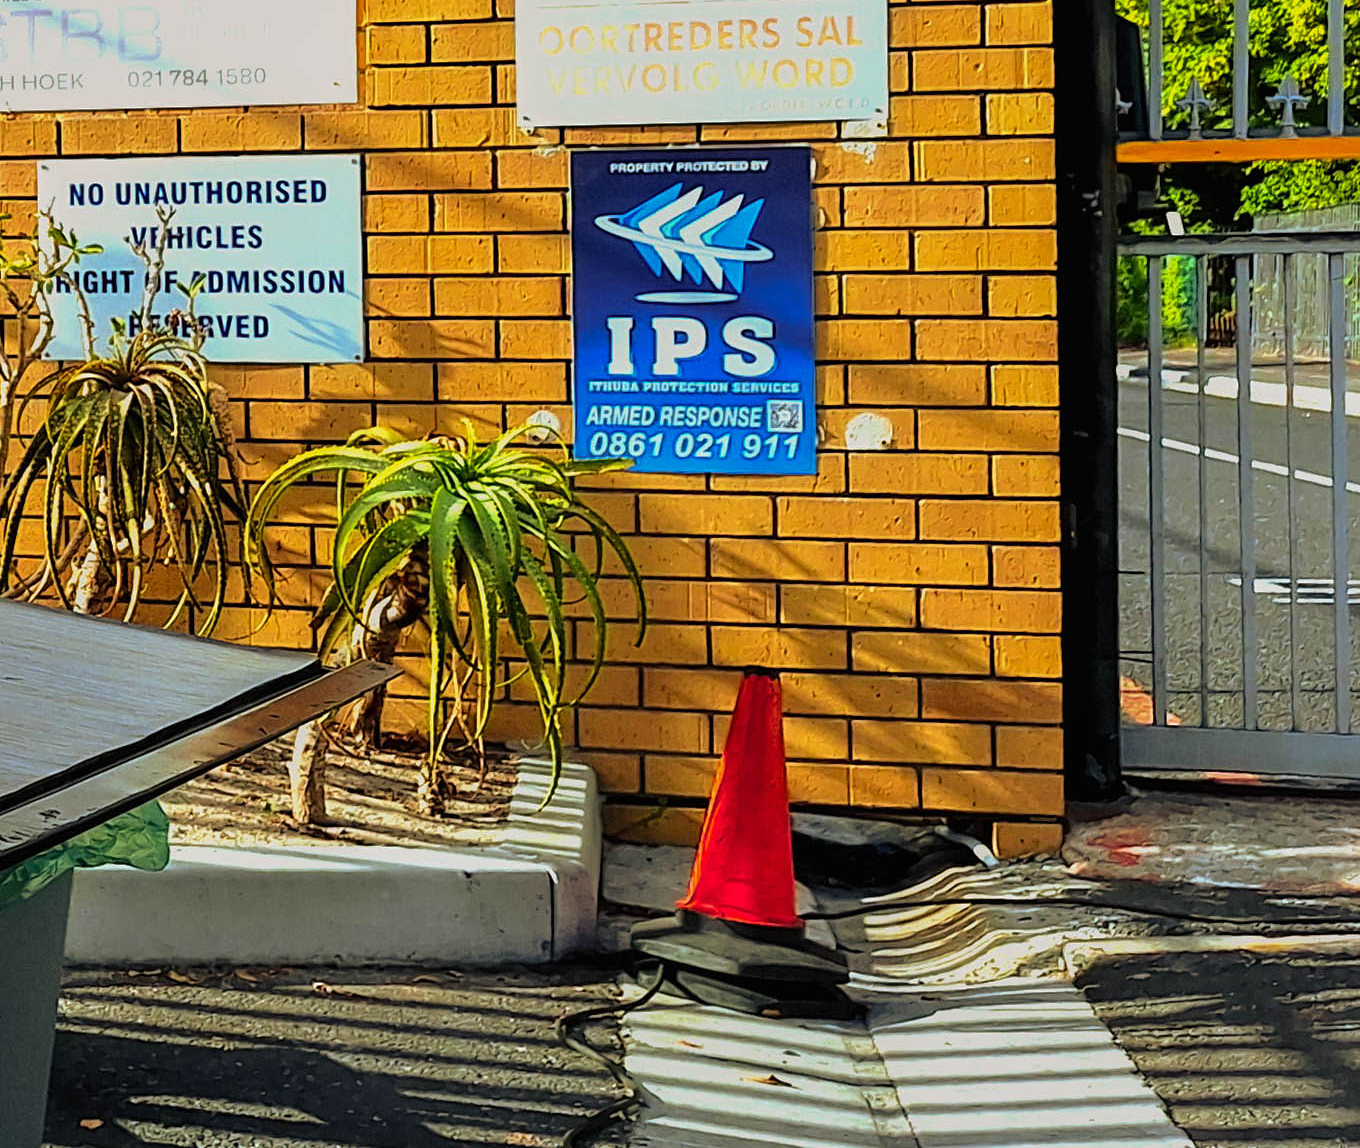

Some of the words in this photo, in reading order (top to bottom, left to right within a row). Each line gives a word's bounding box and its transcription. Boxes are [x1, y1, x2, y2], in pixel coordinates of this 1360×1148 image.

[537, 17, 782, 56] OORTREDERS
[795, 14, 864, 48] SAL
[22, 73, 84, 91] HOEK
[127, 70, 163, 88] 021
[169, 69, 209, 87] 784
[216, 67, 267, 85] 1580
[544, 59, 721, 97] VERVOLG
[735, 56, 856, 92] WORD
[610, 162, 674, 175] PROPERTY
[676, 161, 749, 173] PROTECTED
[750, 160, 769, 172] BY
[68, 182, 105, 207] NO
[115, 178, 328, 205] UNAUTHORISED
[130, 225, 264, 250] VEHICLES
[55, 269, 134, 295] RIGHT
[606, 316, 777, 377] IPS
[588, 380, 640, 393] ITHUBA
[643, 381, 729, 394] PROTECTION
[731, 381, 801, 394] SERVICES
[585, 405, 655, 427] ARMED
[659, 405, 764, 429] RESPONSE
[588, 431, 665, 458] 0861
[674, 432, 732, 459] 021
[742, 434, 800, 460] 911
